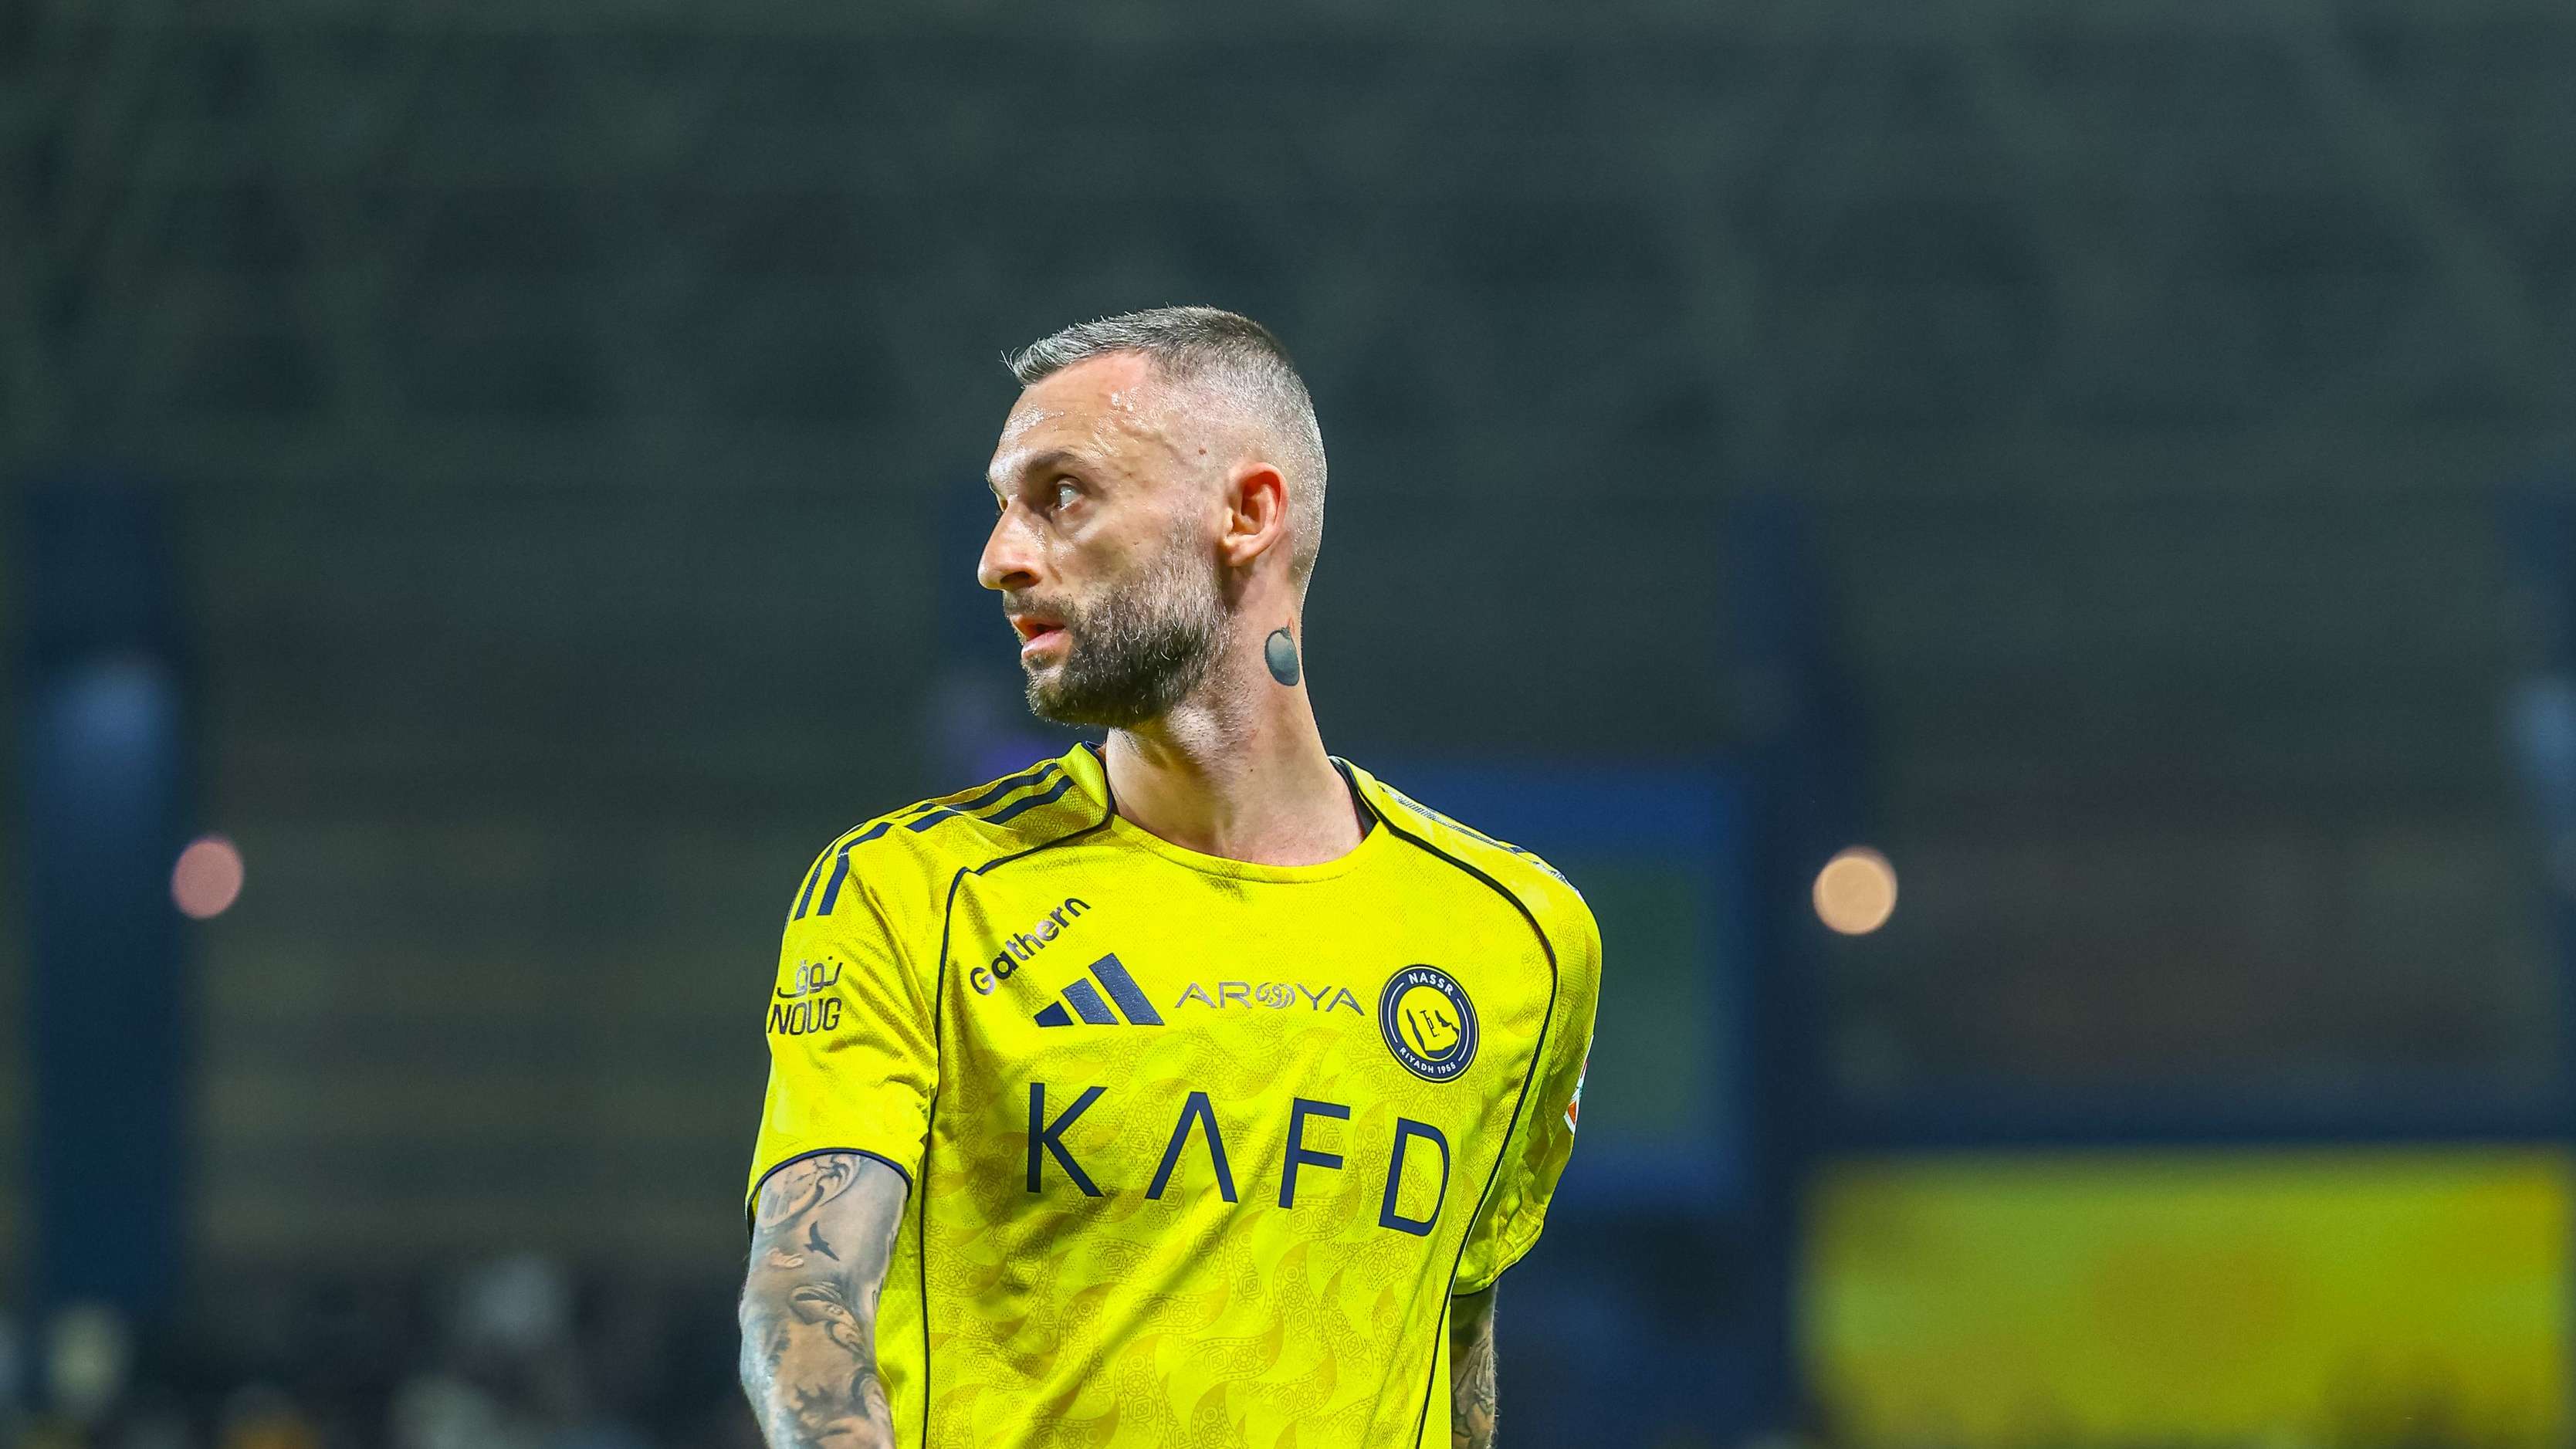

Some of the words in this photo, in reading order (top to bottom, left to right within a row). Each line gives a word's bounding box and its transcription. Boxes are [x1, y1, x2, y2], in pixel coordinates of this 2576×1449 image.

[970, 898, 1091, 995] Gathern
[1408, 972, 1454, 996] NASSR
[768, 997, 841, 1035] NOUG
[1400, 1047, 1434, 1074] RIYADH
[1437, 1061, 1456, 1074] 1955
[1026, 1082, 1450, 1237] KAFD
